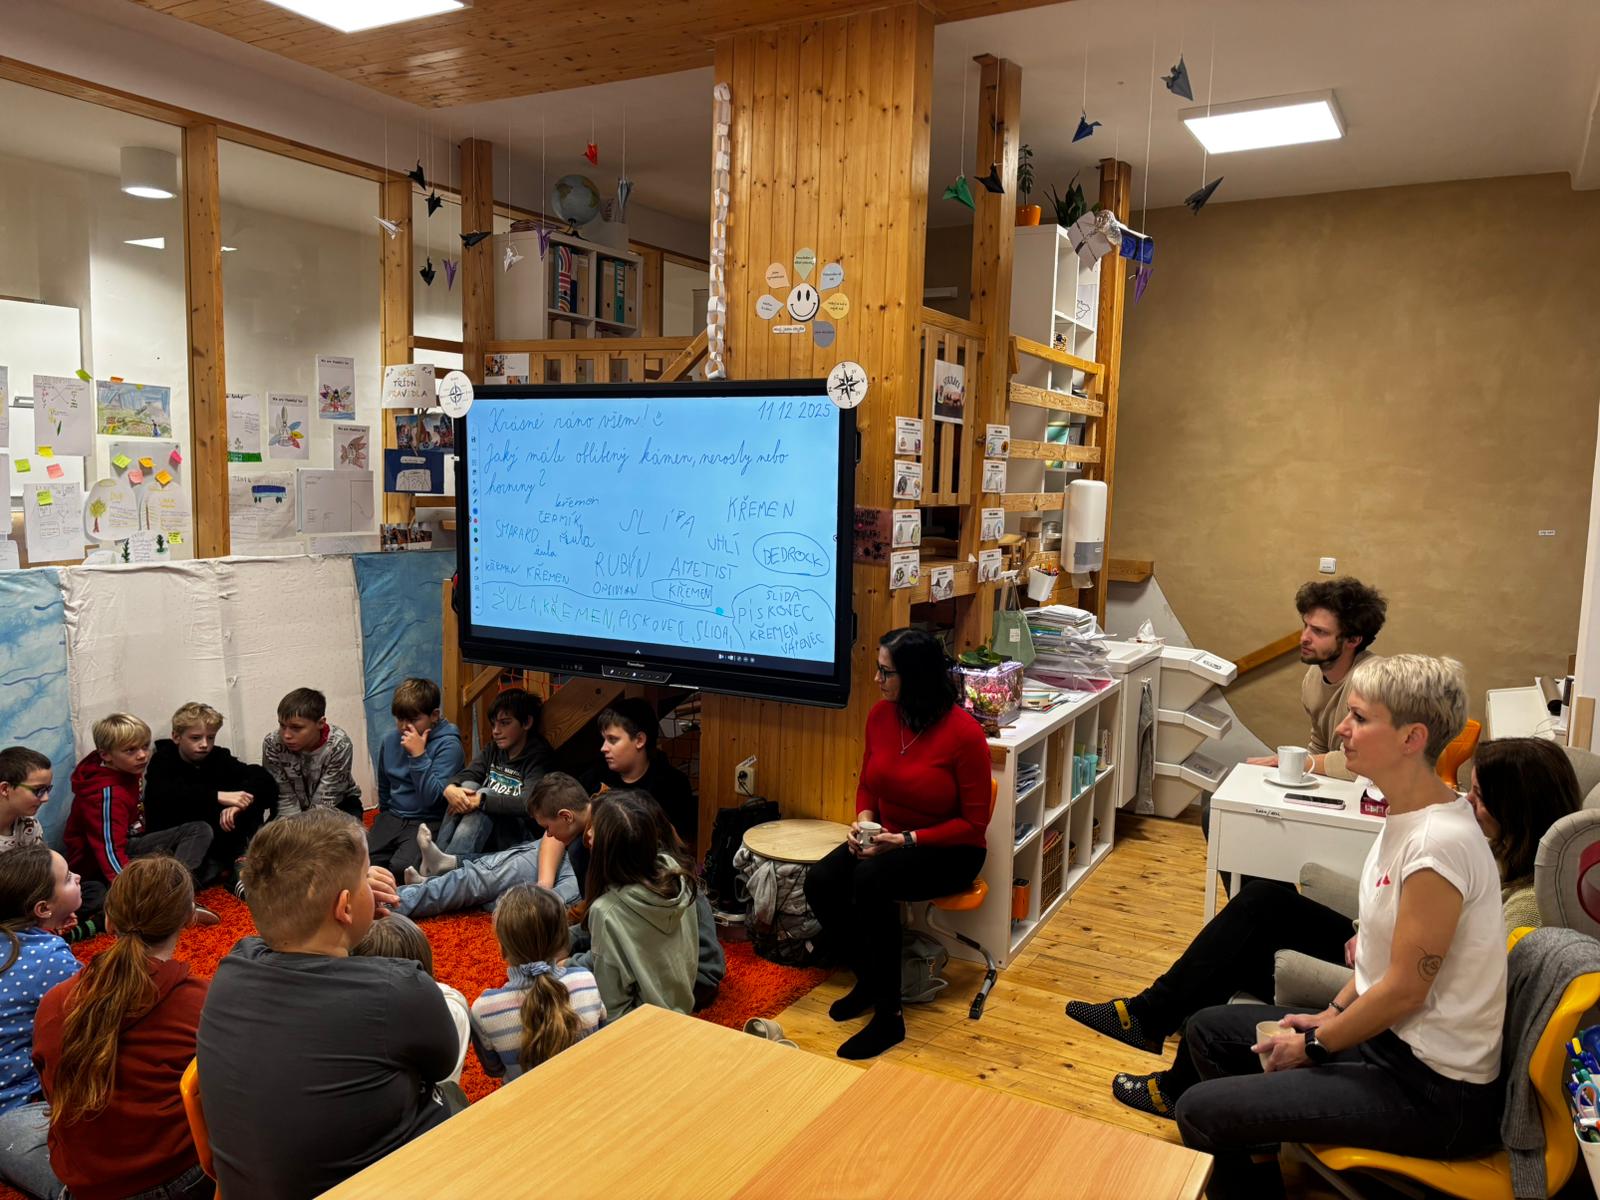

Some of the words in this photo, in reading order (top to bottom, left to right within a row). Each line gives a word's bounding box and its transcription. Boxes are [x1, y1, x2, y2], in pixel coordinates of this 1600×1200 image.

[553, 411, 593, 430] ráno
[756, 438, 789, 464] nebo
[727, 495, 795, 522] KŘEMEN
[594, 545, 651, 578] RUBÍN
[763, 546, 824, 568] BEDROCK
